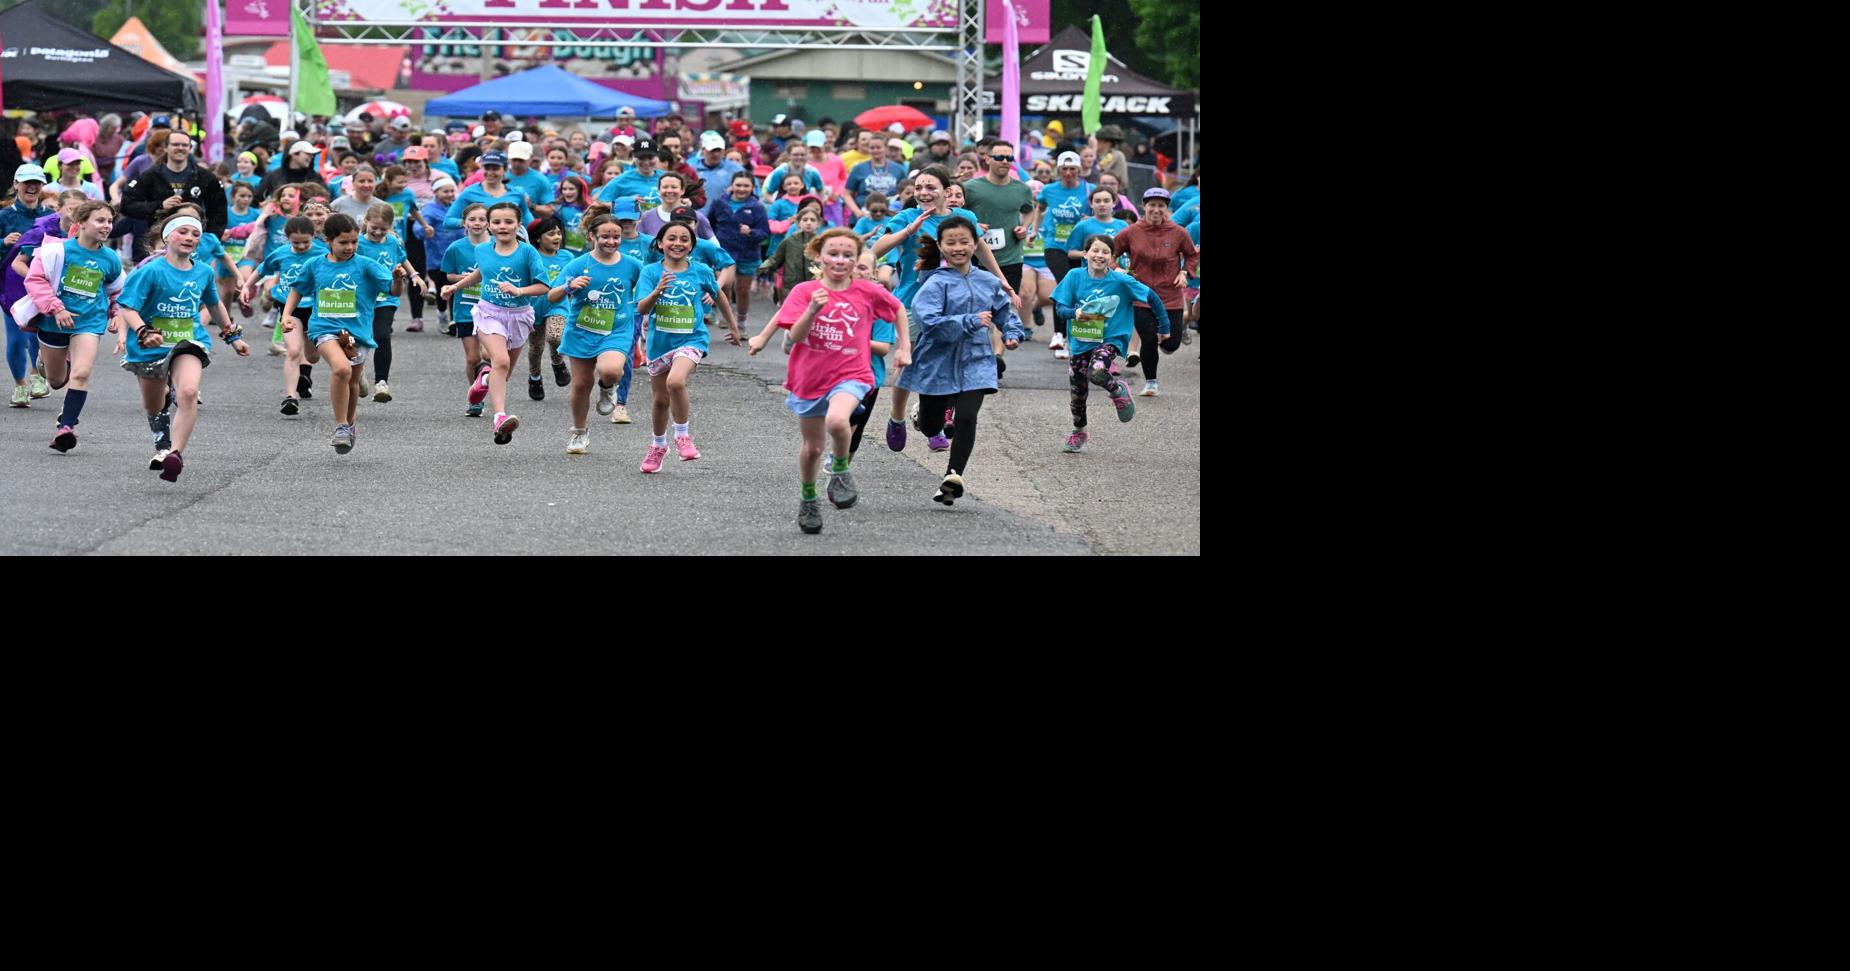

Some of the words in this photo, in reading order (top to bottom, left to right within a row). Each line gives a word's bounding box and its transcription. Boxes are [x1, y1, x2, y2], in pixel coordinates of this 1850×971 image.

[553, 29, 653, 66] Dough
[1030, 71, 1119, 83] salomn
[1026, 94, 1171, 114] SKIACK
[157, 302, 186, 312] Girls
[318, 300, 354, 308] Mariana
[583, 315, 606, 326] Olive
[656, 314, 693, 324] Mariana
[1072, 325, 1102, 335] Rosetta
[818, 331, 843, 341] run
